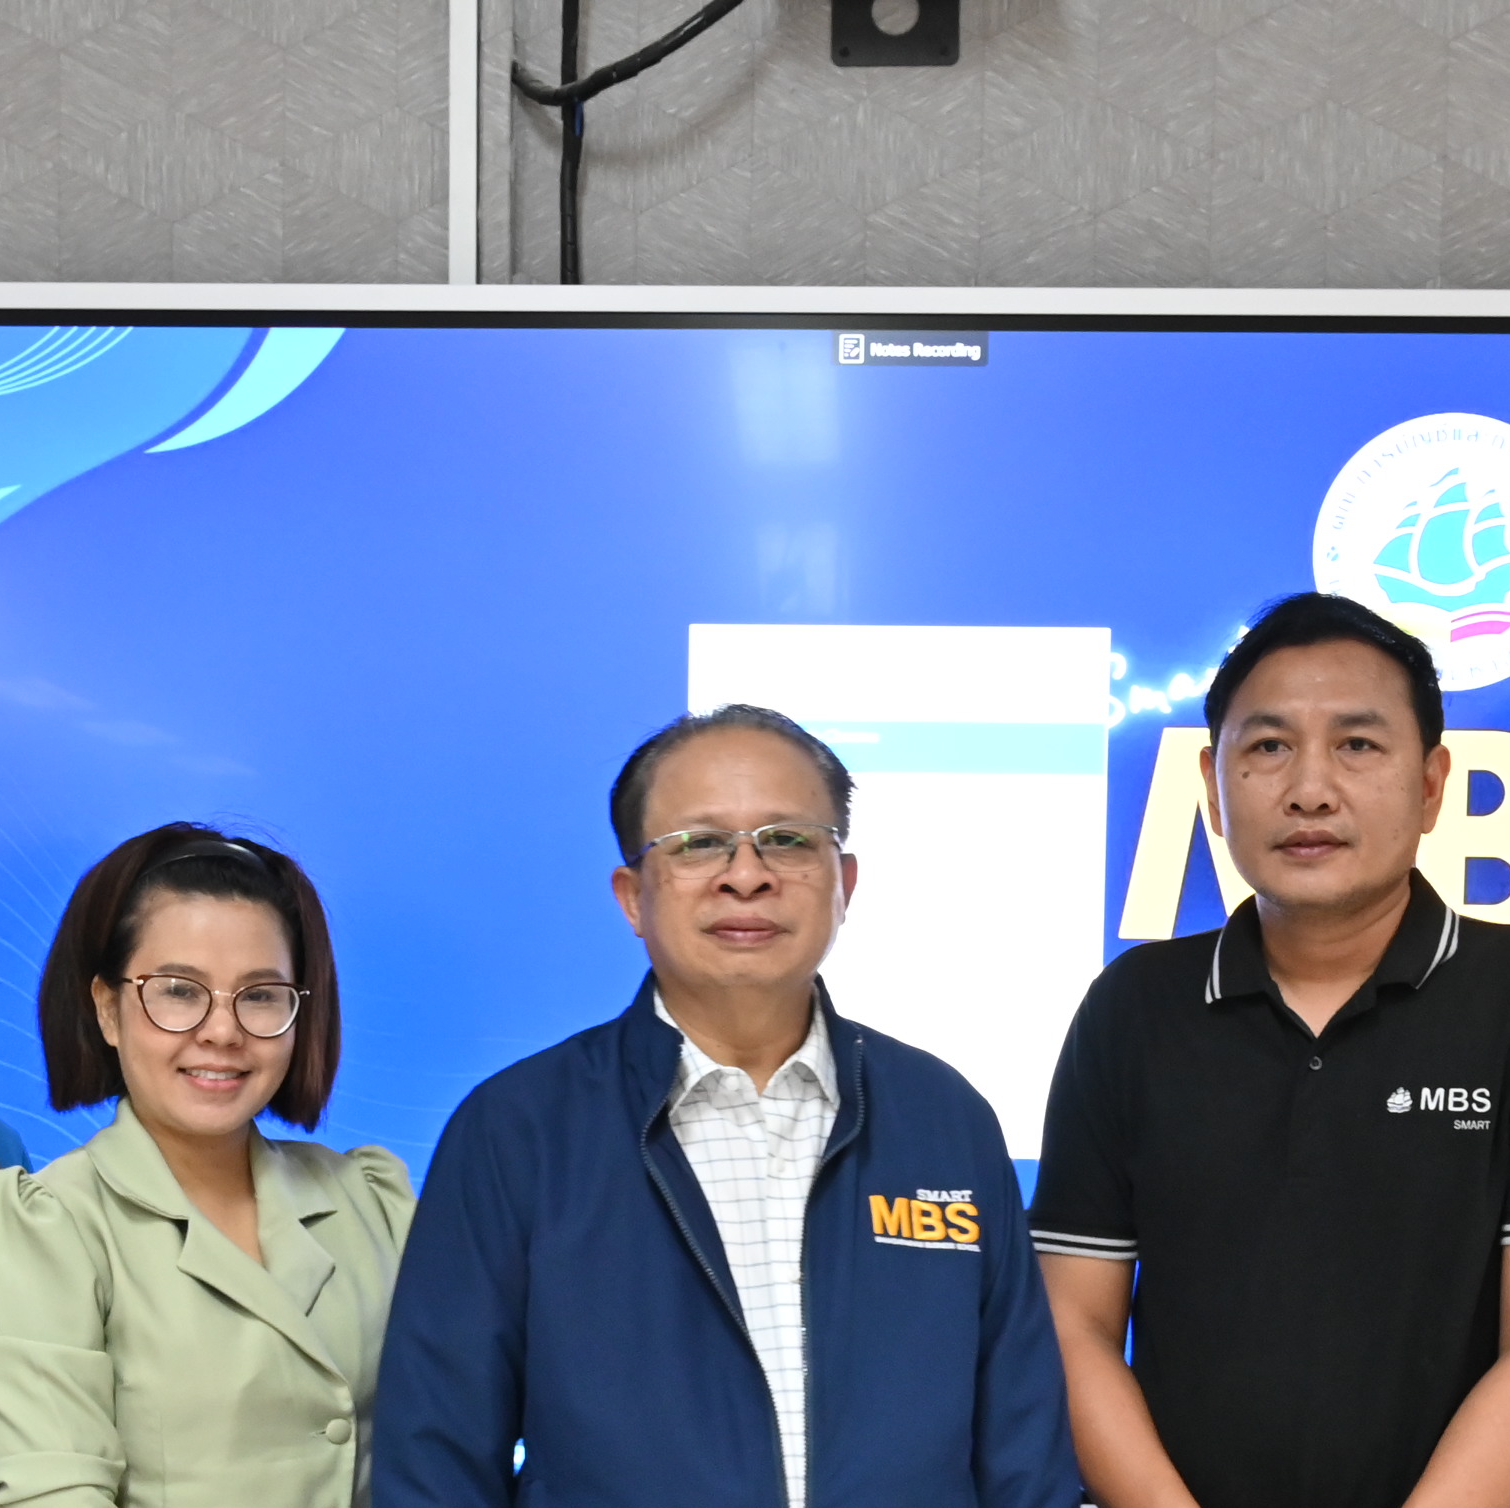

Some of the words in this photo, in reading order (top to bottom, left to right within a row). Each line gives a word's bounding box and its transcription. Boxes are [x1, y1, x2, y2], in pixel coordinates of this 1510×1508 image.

[870, 342, 911, 357] Notes
[913, 342, 981, 361] Recording
[1419, 1087, 1491, 1113] MBS
[1453, 1119, 1491, 1130] SMART
[915, 1188, 973, 1202] SMART
[868, 1194, 981, 1243] MBS
